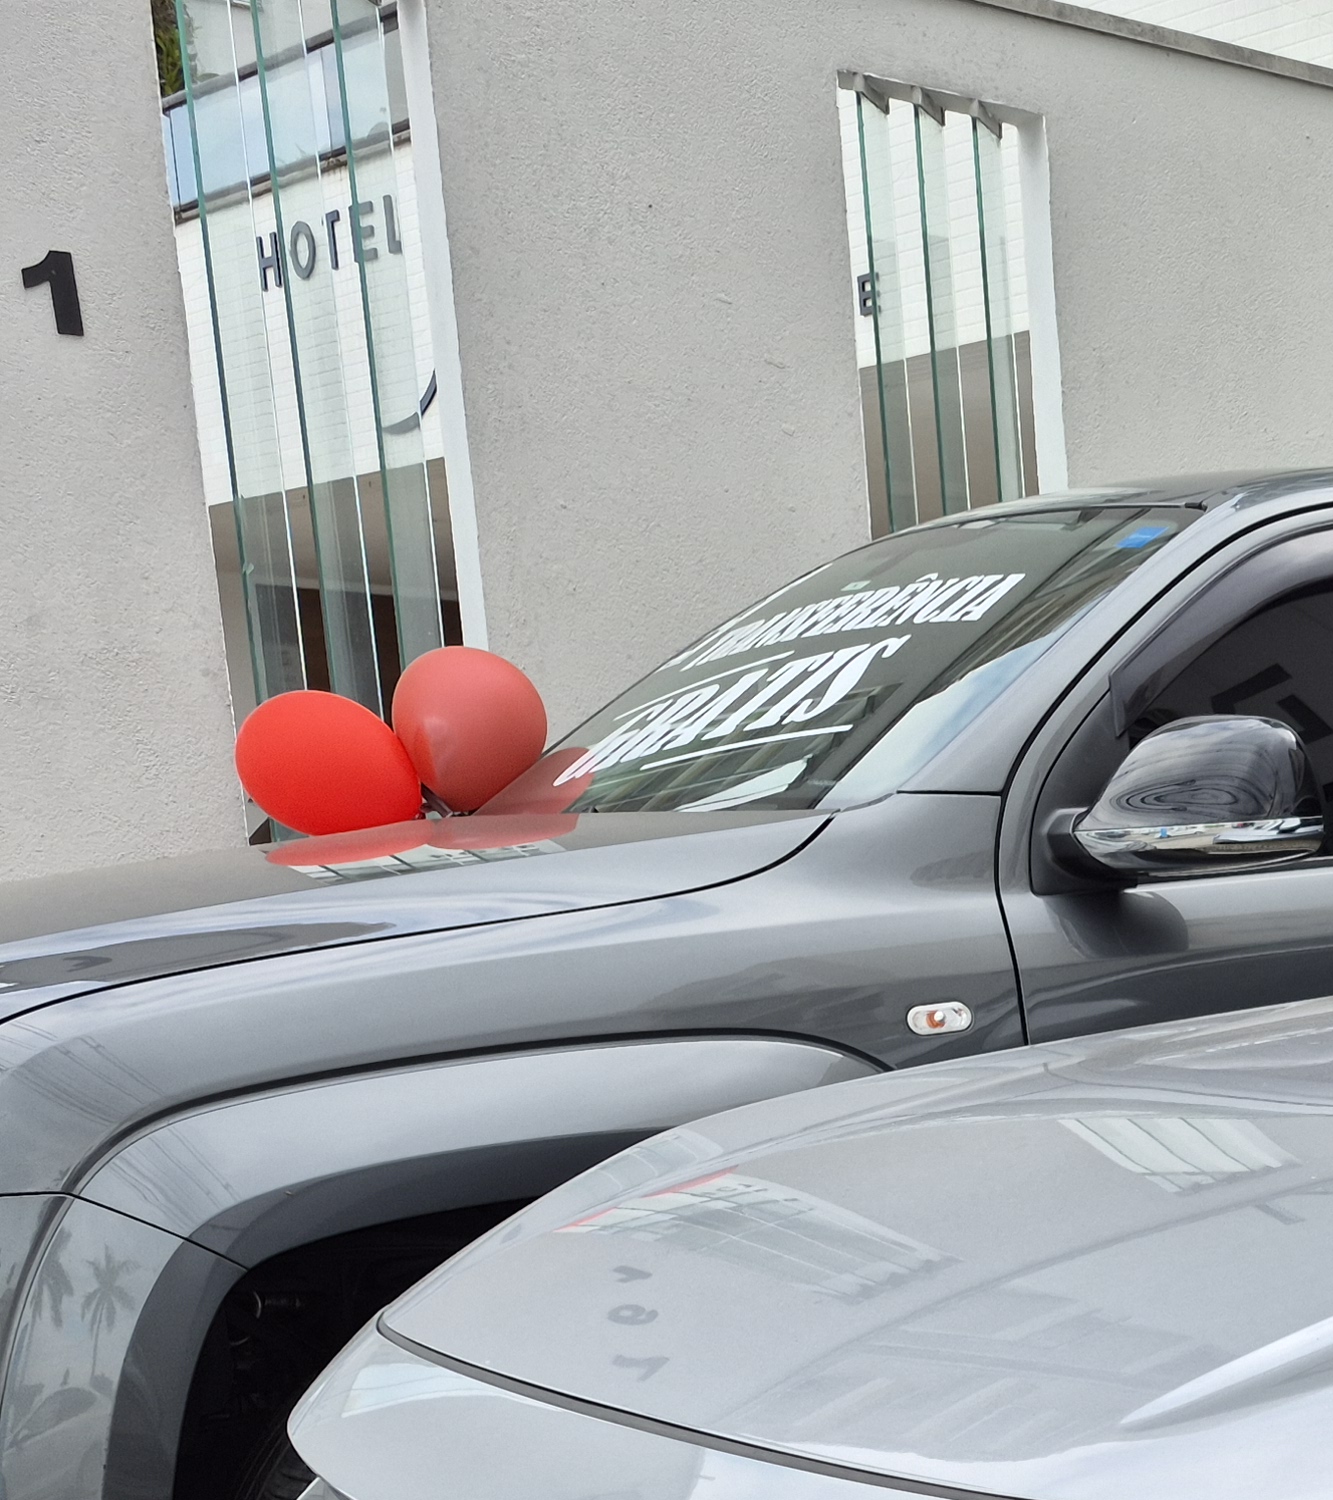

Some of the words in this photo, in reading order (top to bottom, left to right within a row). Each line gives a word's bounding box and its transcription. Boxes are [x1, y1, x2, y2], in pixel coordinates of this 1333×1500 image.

[255, 194, 403, 292] HOTEL
[21, 249, 85, 337] 1
[682, 573, 1025, 672] TRANSFERÊNCIA
